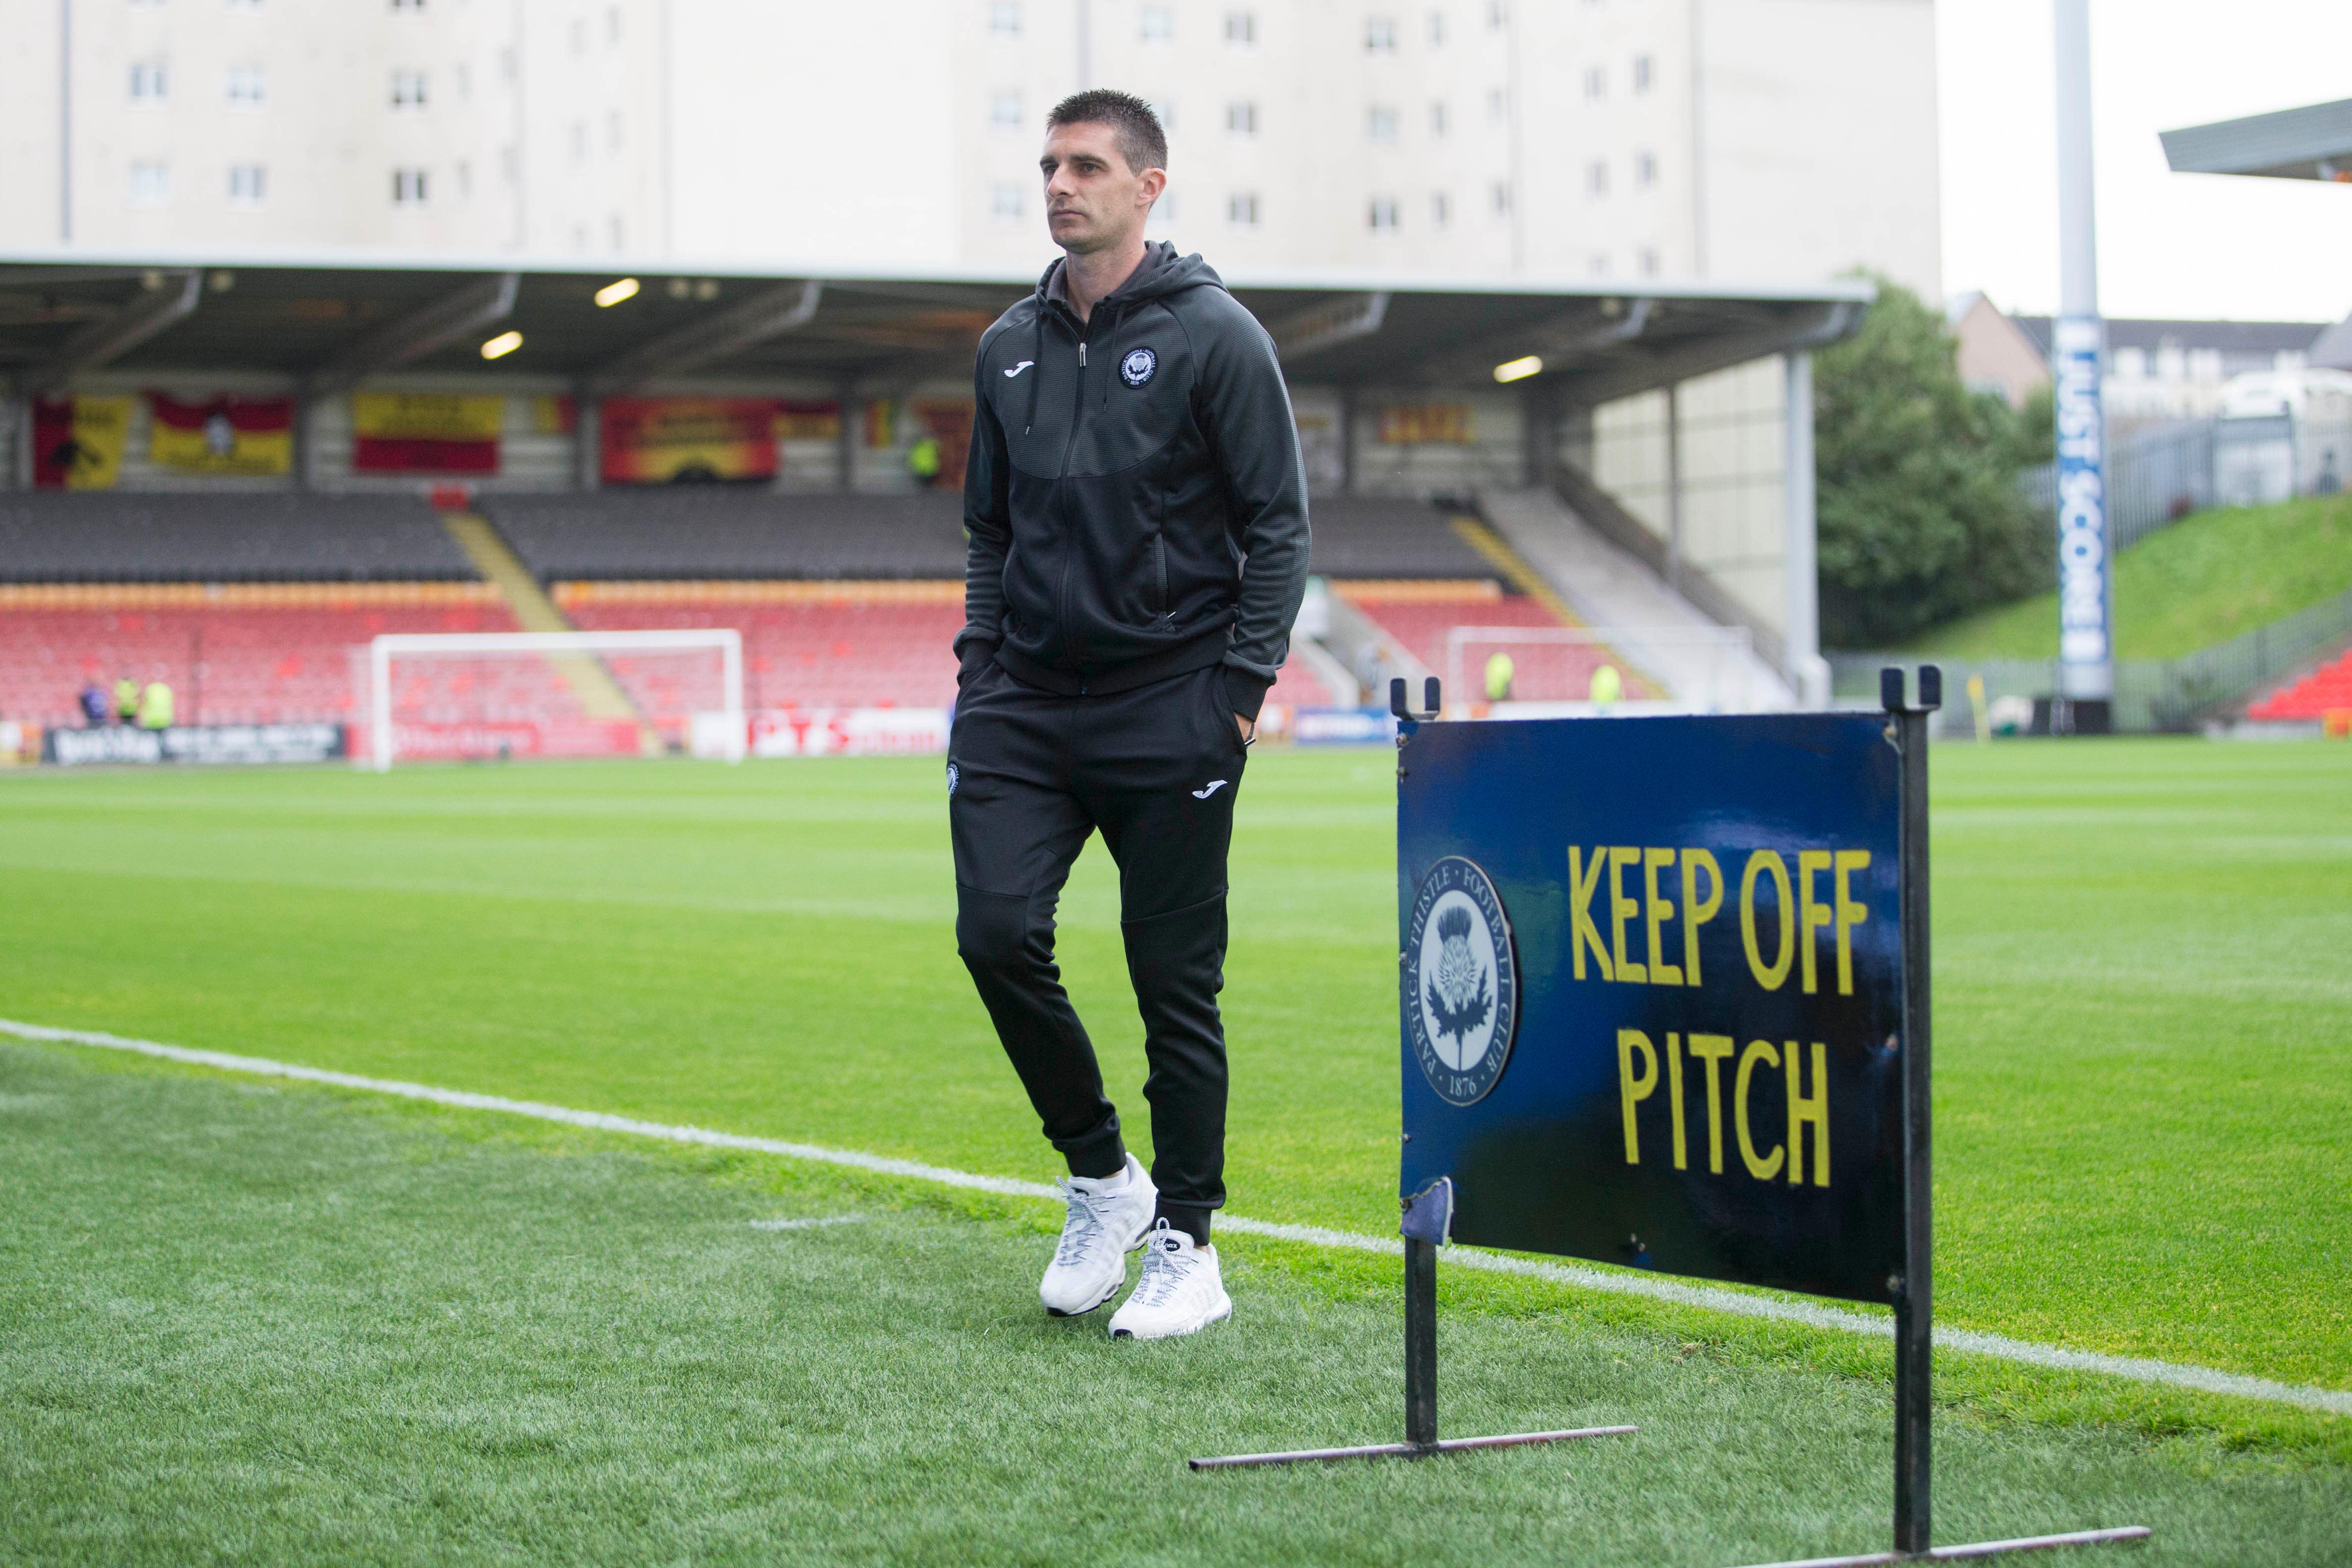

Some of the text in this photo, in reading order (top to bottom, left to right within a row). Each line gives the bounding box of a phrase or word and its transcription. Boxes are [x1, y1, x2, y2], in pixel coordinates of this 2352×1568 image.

[1143, 370, 1154, 381] CLUB
[1408, 865, 1511, 1075] PARTICK THISTLE FOOTBALL CLUB
[1569, 846, 1870, 996] KEEP OFF
[1449, 1074, 1478, 1097] 1876
[1618, 1030, 1830, 1187] PITCH
